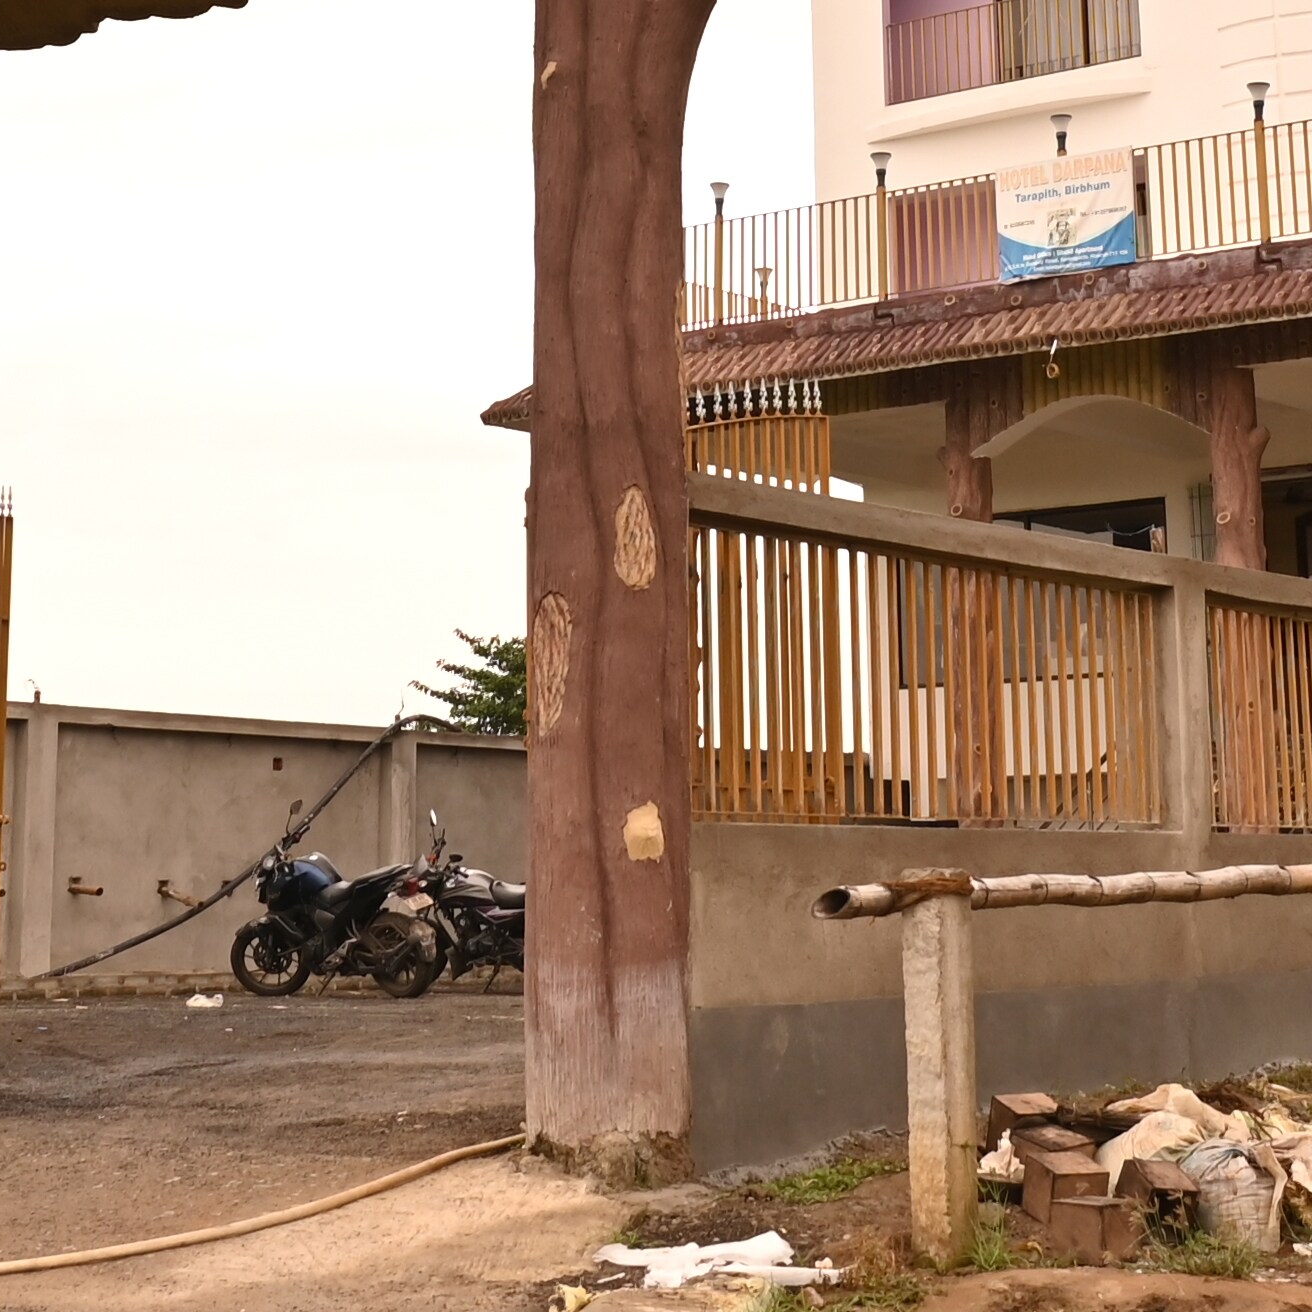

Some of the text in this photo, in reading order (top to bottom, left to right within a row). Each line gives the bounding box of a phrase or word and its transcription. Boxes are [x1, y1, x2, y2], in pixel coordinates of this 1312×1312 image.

[999, 152, 1128, 192] HOTEL DARPANA
[1064, 181, 1110, 195] Birbhum
